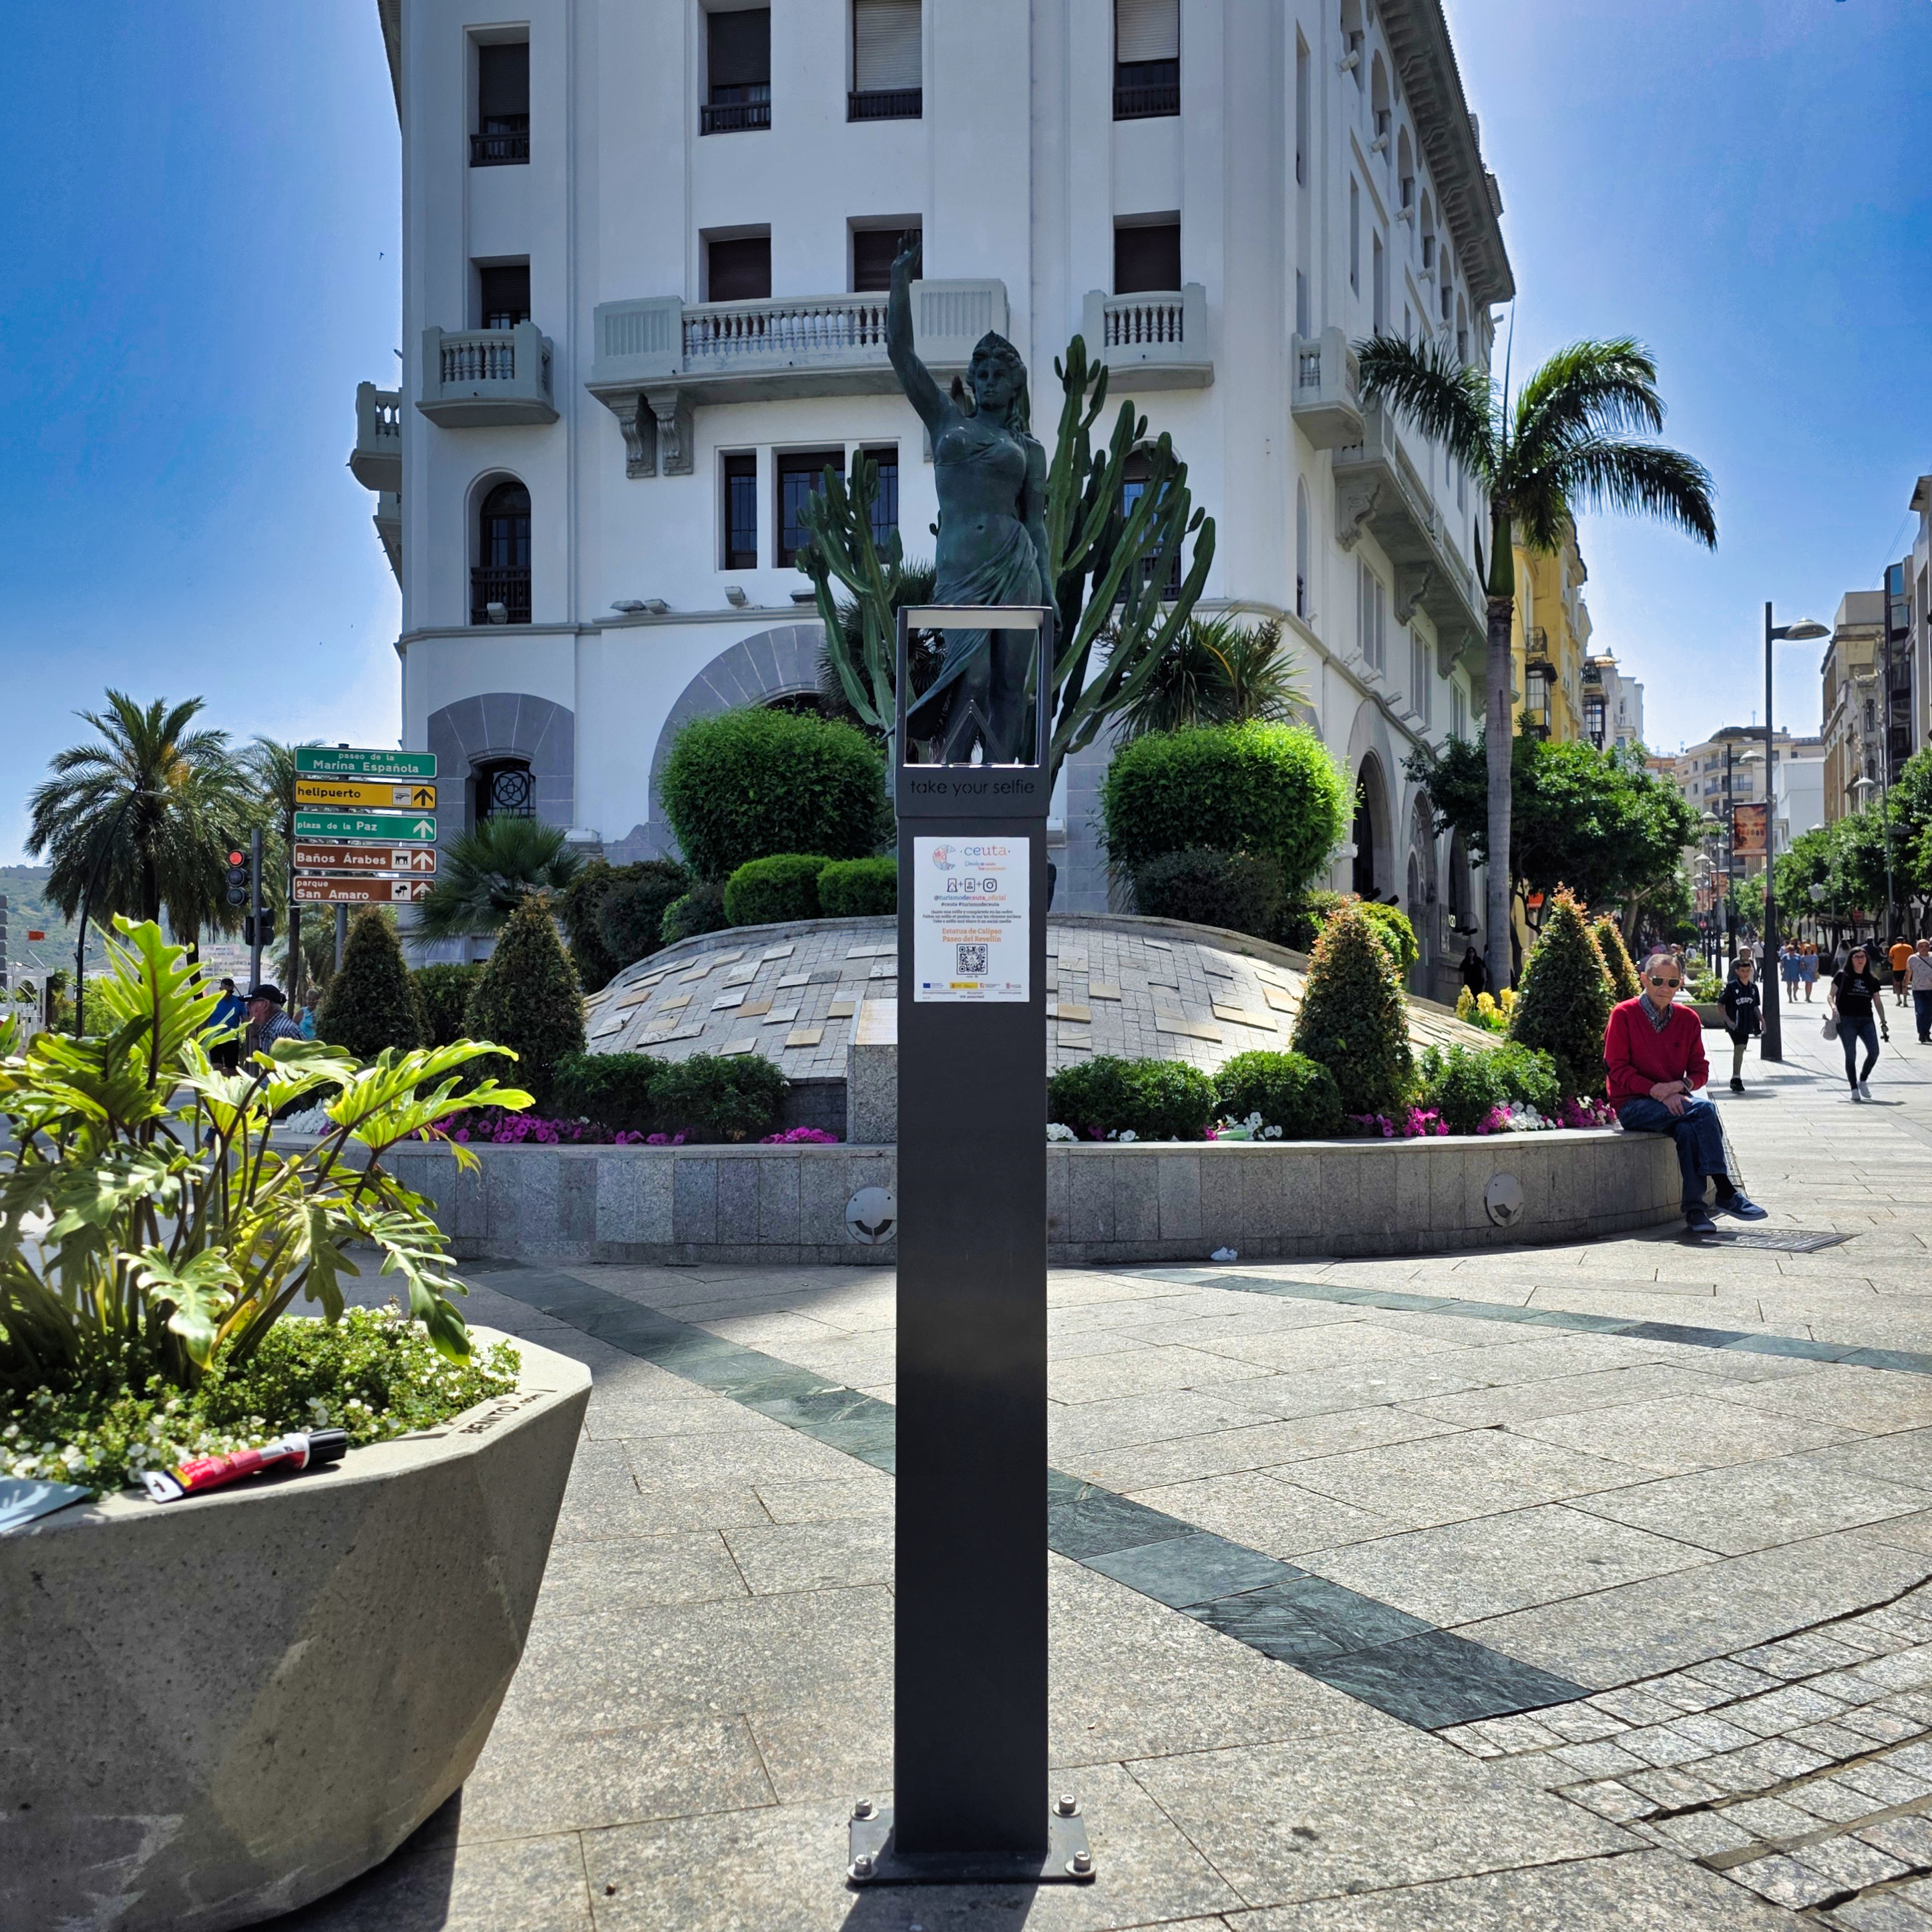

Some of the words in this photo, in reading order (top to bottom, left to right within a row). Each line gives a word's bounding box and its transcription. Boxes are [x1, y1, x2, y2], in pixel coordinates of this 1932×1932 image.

[313, 760, 355, 770] Marina
[363, 762, 419, 773] Española
[297, 787, 361, 798] helipuerto
[911, 780, 947, 794] take
[952, 783, 988, 797] your
[993, 779, 1034, 794] selfie
[297, 821, 321, 829] plaza
[356, 821, 377, 831] Paz
[297, 853, 335, 863] Baños
[343, 852, 386, 865] Árabes
[297, 880, 329, 888] parque
[297, 890, 321, 898] San
[329, 890, 369, 900] Amaro
[978, 928, 1002, 936] Calipso
